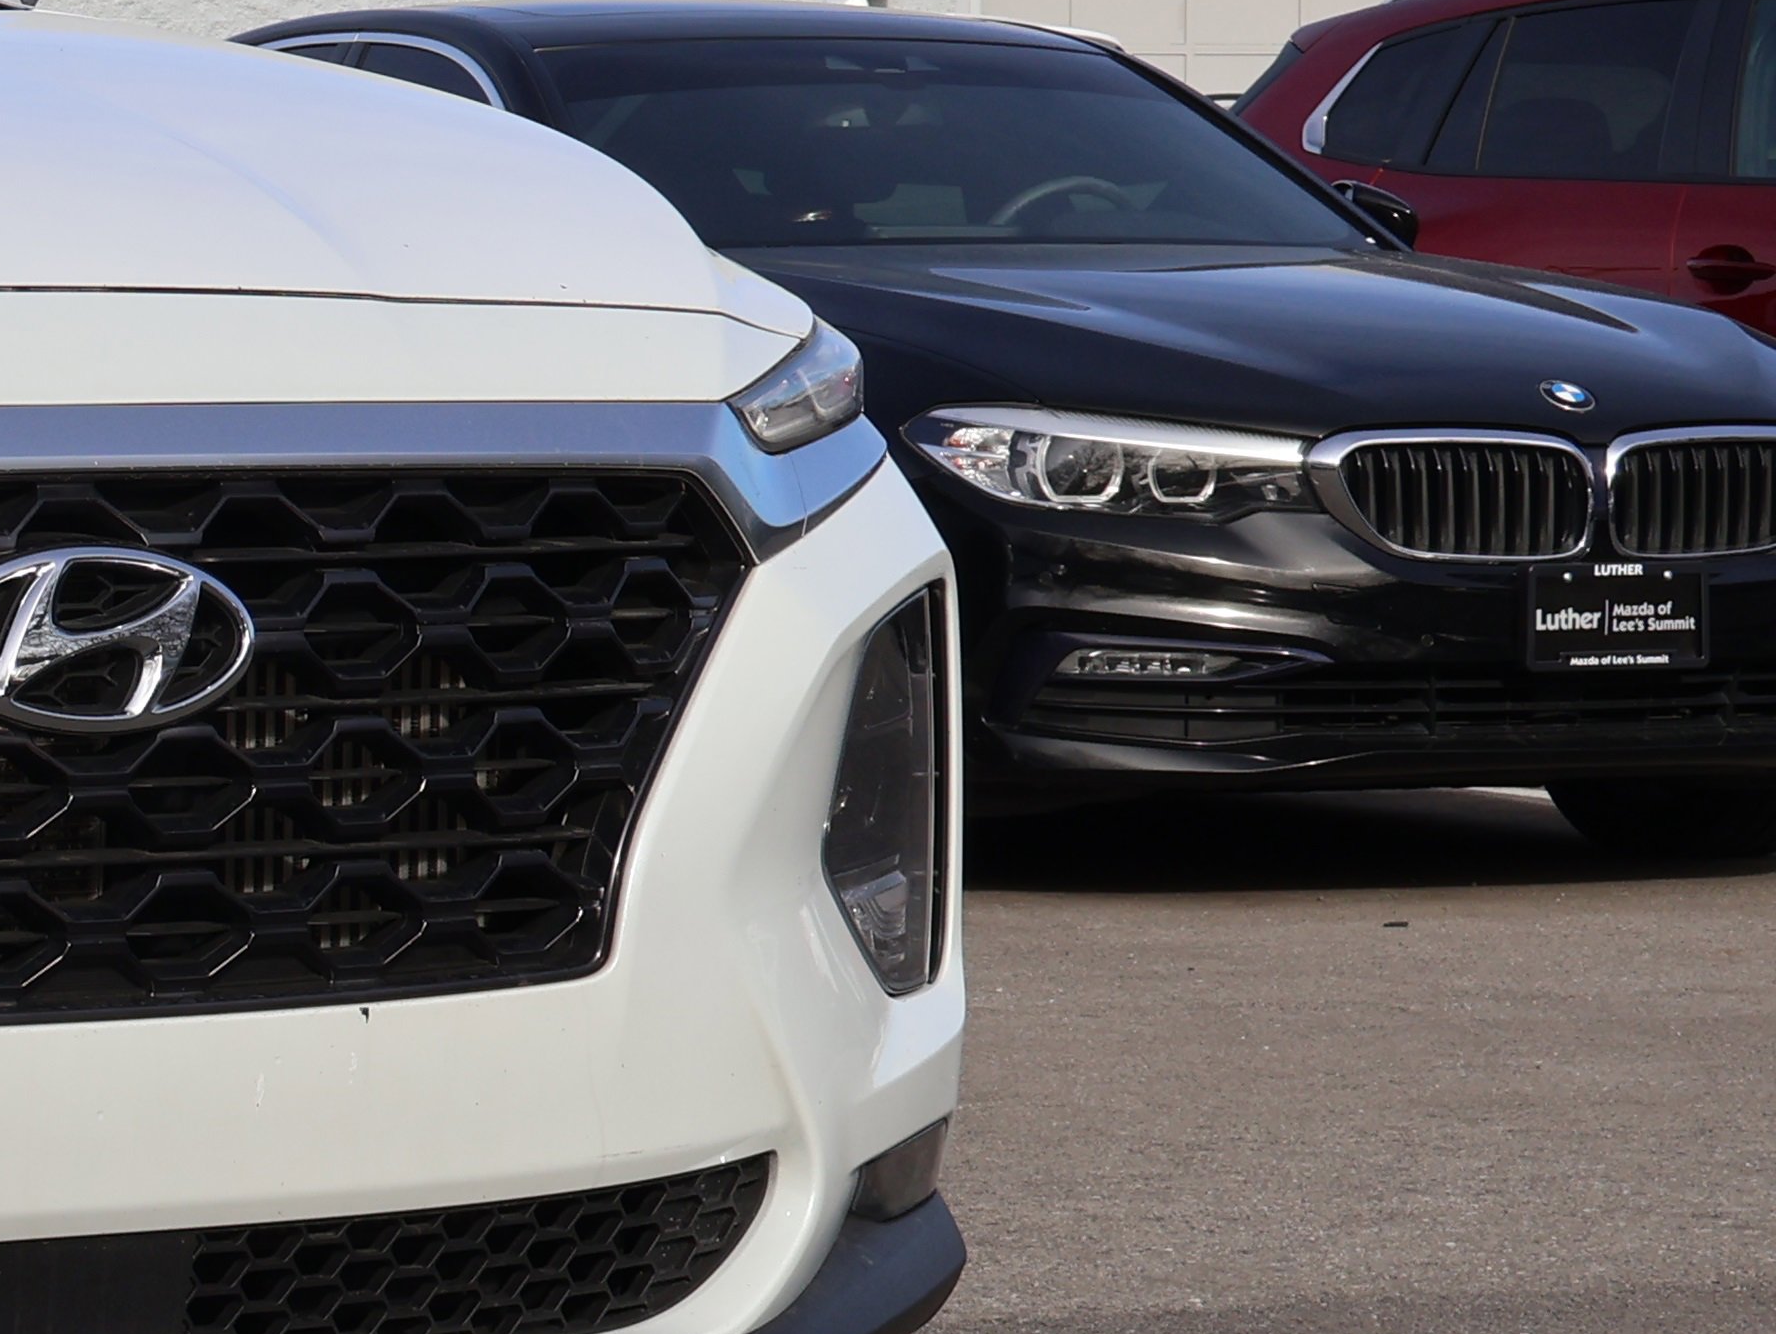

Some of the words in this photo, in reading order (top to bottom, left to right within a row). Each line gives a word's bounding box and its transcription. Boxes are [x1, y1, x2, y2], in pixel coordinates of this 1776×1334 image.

[1594, 564, 1643, 576] LUTHER
[1612, 602, 1654, 616] Mazda
[1657, 601, 1673, 616] of
[1535, 607, 1602, 631] Luther
[1612, 618, 1645, 632] Lee's
[1648, 616, 1696, 631] Summit
[1569, 655, 1600, 666] Mazda
[1601, 655, 1611, 665] of
[1636, 654, 1669, 664] Summit
